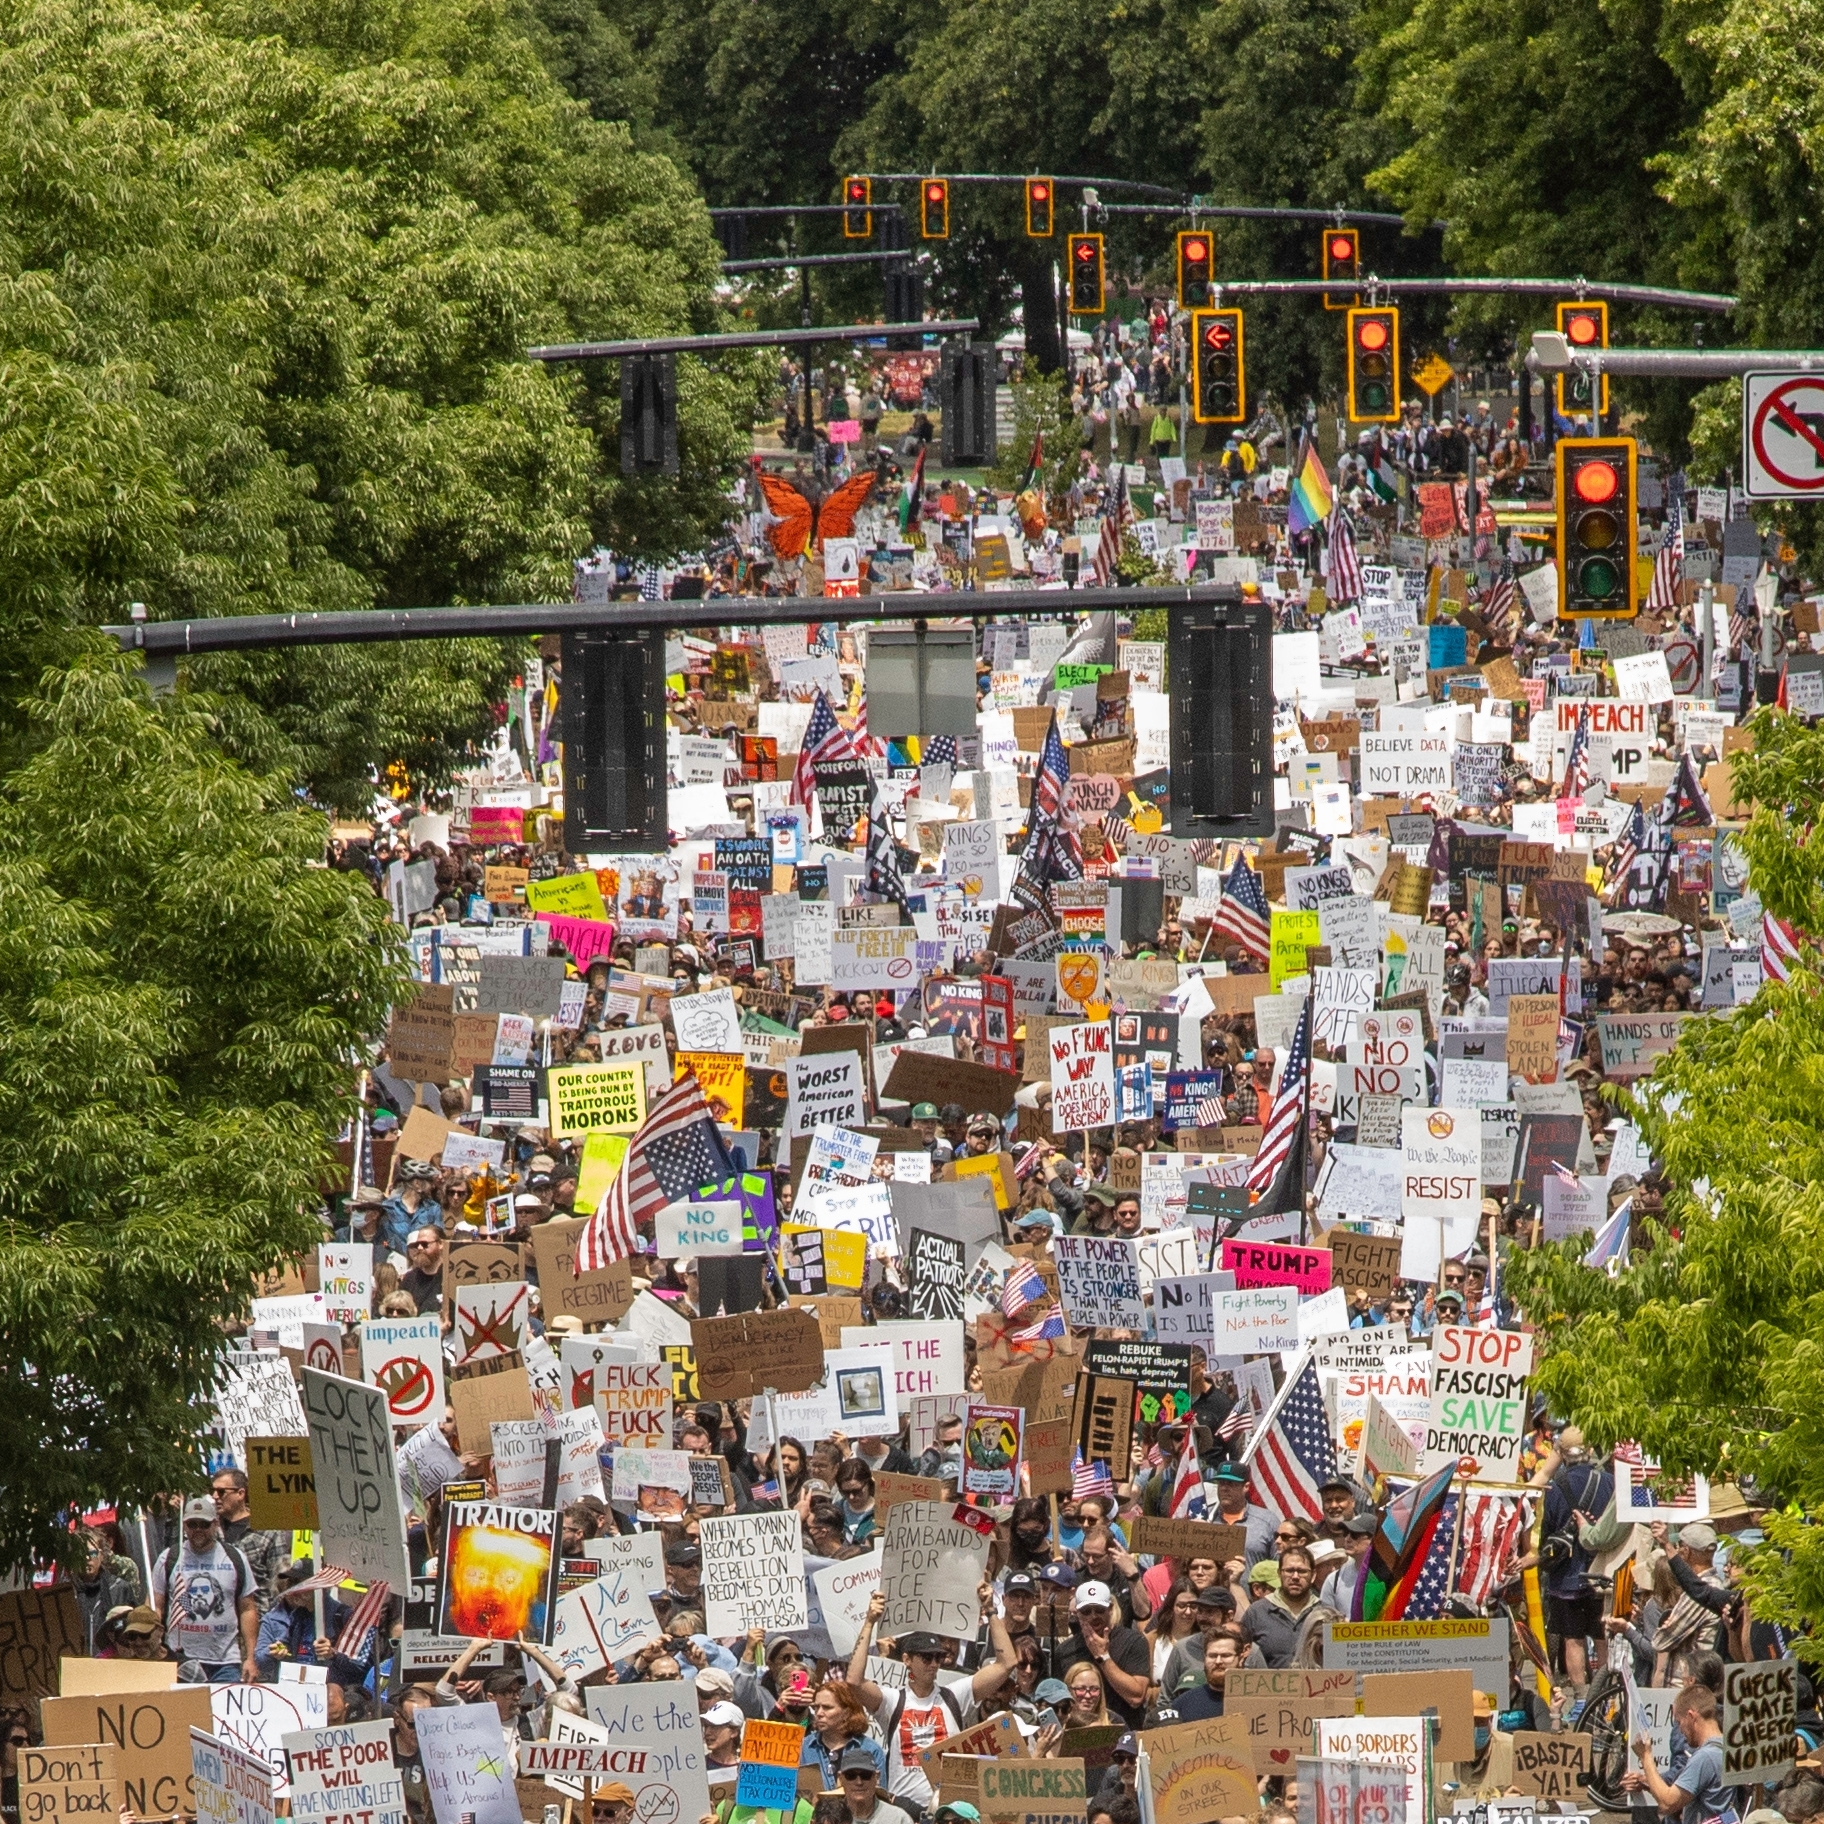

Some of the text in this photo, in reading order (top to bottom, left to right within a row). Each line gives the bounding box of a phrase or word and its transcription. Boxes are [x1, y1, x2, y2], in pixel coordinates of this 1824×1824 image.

[1366, 740, 1446, 753] BELIEVE DATA
[1370, 766, 1445, 782] NOT DRAMA
[558, 1070, 633, 1086] OUR COUNTRY
[559, 1084, 634, 1098] IS BEING RUN BY
[560, 1094, 636, 1111] TRAITOROUS
[561, 1108, 639, 1129] MORONS
[1406, 1176, 1476, 1199] RESIST
[687, 1210, 714, 1225] NO
[679, 1229, 729, 1245] KING
[917, 1234, 963, 1265] ACTUAL
[1056, 1237, 1129, 1262] THE POWER
[1231, 1246, 1319, 1275] TRUMP
[916, 1257, 964, 1289] PATRIOTS
[1060, 1259, 1135, 1282] OF THE PEOPLE
[1064, 1278, 1139, 1302] IS STRONGER
[366, 1321, 439, 1344] impeach
[1120, 1344, 1162, 1355] REBUKE
[1438, 1329, 1521, 1366] STOP
[1435, 1368, 1524, 1400] FASCISM
[304, 1372, 384, 1433] LOCK
[1442, 1398, 1516, 1432] SAVE
[1427, 1430, 1518, 1459] DEMOCRACY
[337, 1477, 381, 1524] UP
[456, 1503, 552, 1534] TRAITOR
[703, 1516, 797, 1542] WHEN TYRANNY
[705, 1540, 755, 1556] BECOMES
[708, 1556, 786, 1581] REBELLION
[708, 1577, 804, 1599] BECOMES DUTY
[738, 1613, 804, 1630] JEFFERSON
[1333, 1620, 1489, 1639] TOGETHER WE STAND
[26, 1751, 103, 1781] Don't
[528, 1746, 647, 1773] IMPEACH
[27, 1785, 110, 1820] go back
